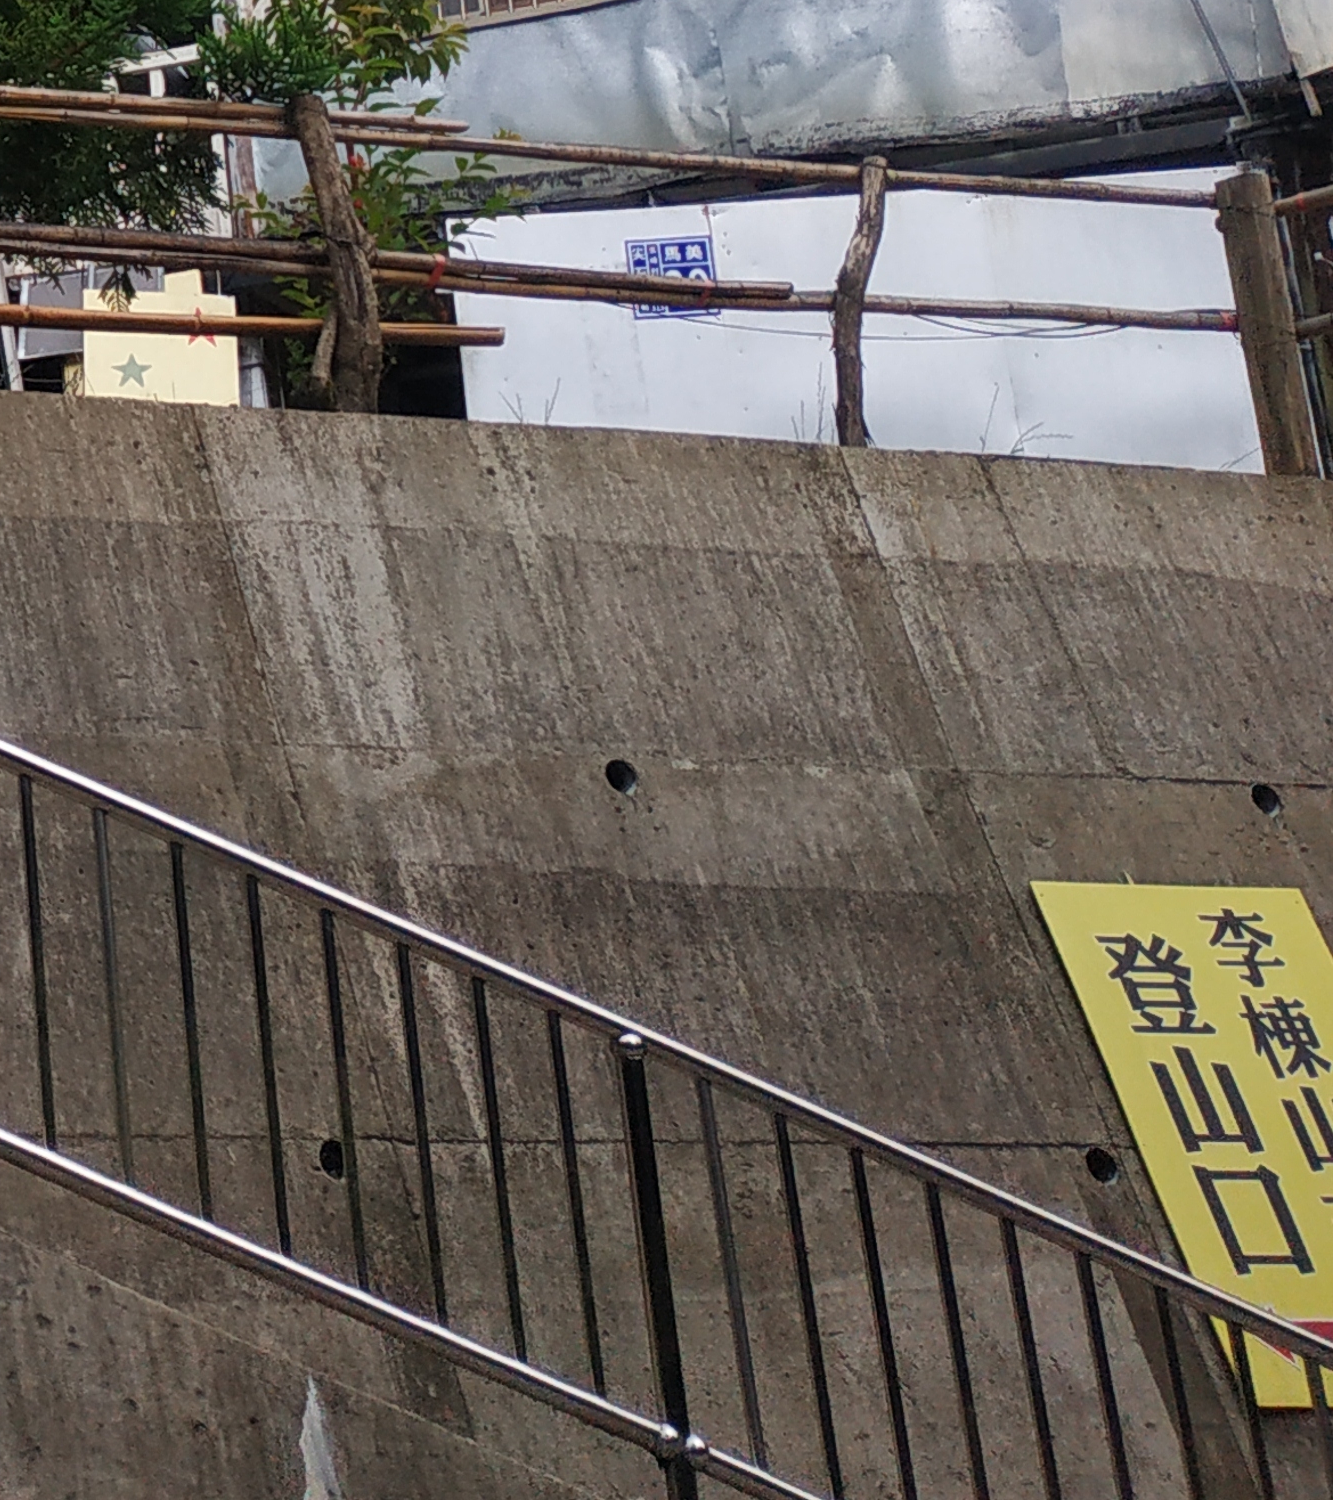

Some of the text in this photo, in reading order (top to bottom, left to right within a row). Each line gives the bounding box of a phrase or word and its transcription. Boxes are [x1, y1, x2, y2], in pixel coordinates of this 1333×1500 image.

[1095, 933, 1315, 1275] 登山口
[1197, 908, 1333, 1203] 李棟山
